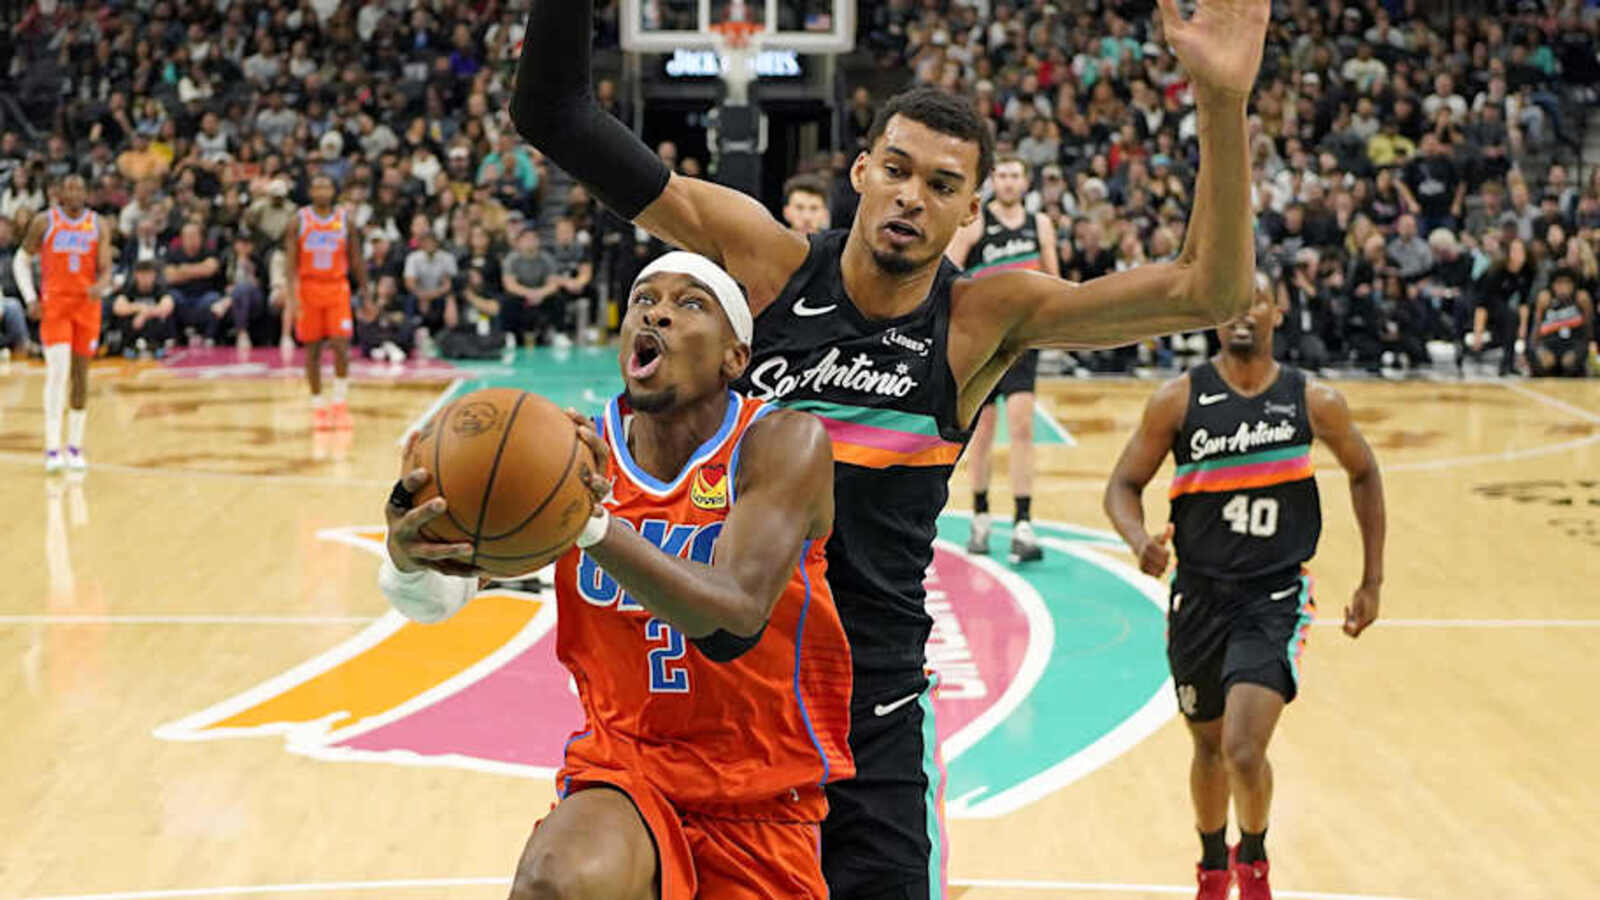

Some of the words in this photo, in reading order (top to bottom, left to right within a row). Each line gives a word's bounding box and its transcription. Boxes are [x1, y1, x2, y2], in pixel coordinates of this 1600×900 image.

[801, 347, 918, 397] Antonio
[1190, 428, 1227, 461] San
[1227, 418, 1296, 453] Antonio
[1222, 494, 1279, 537] 40
[645, 616, 690, 693] 2
